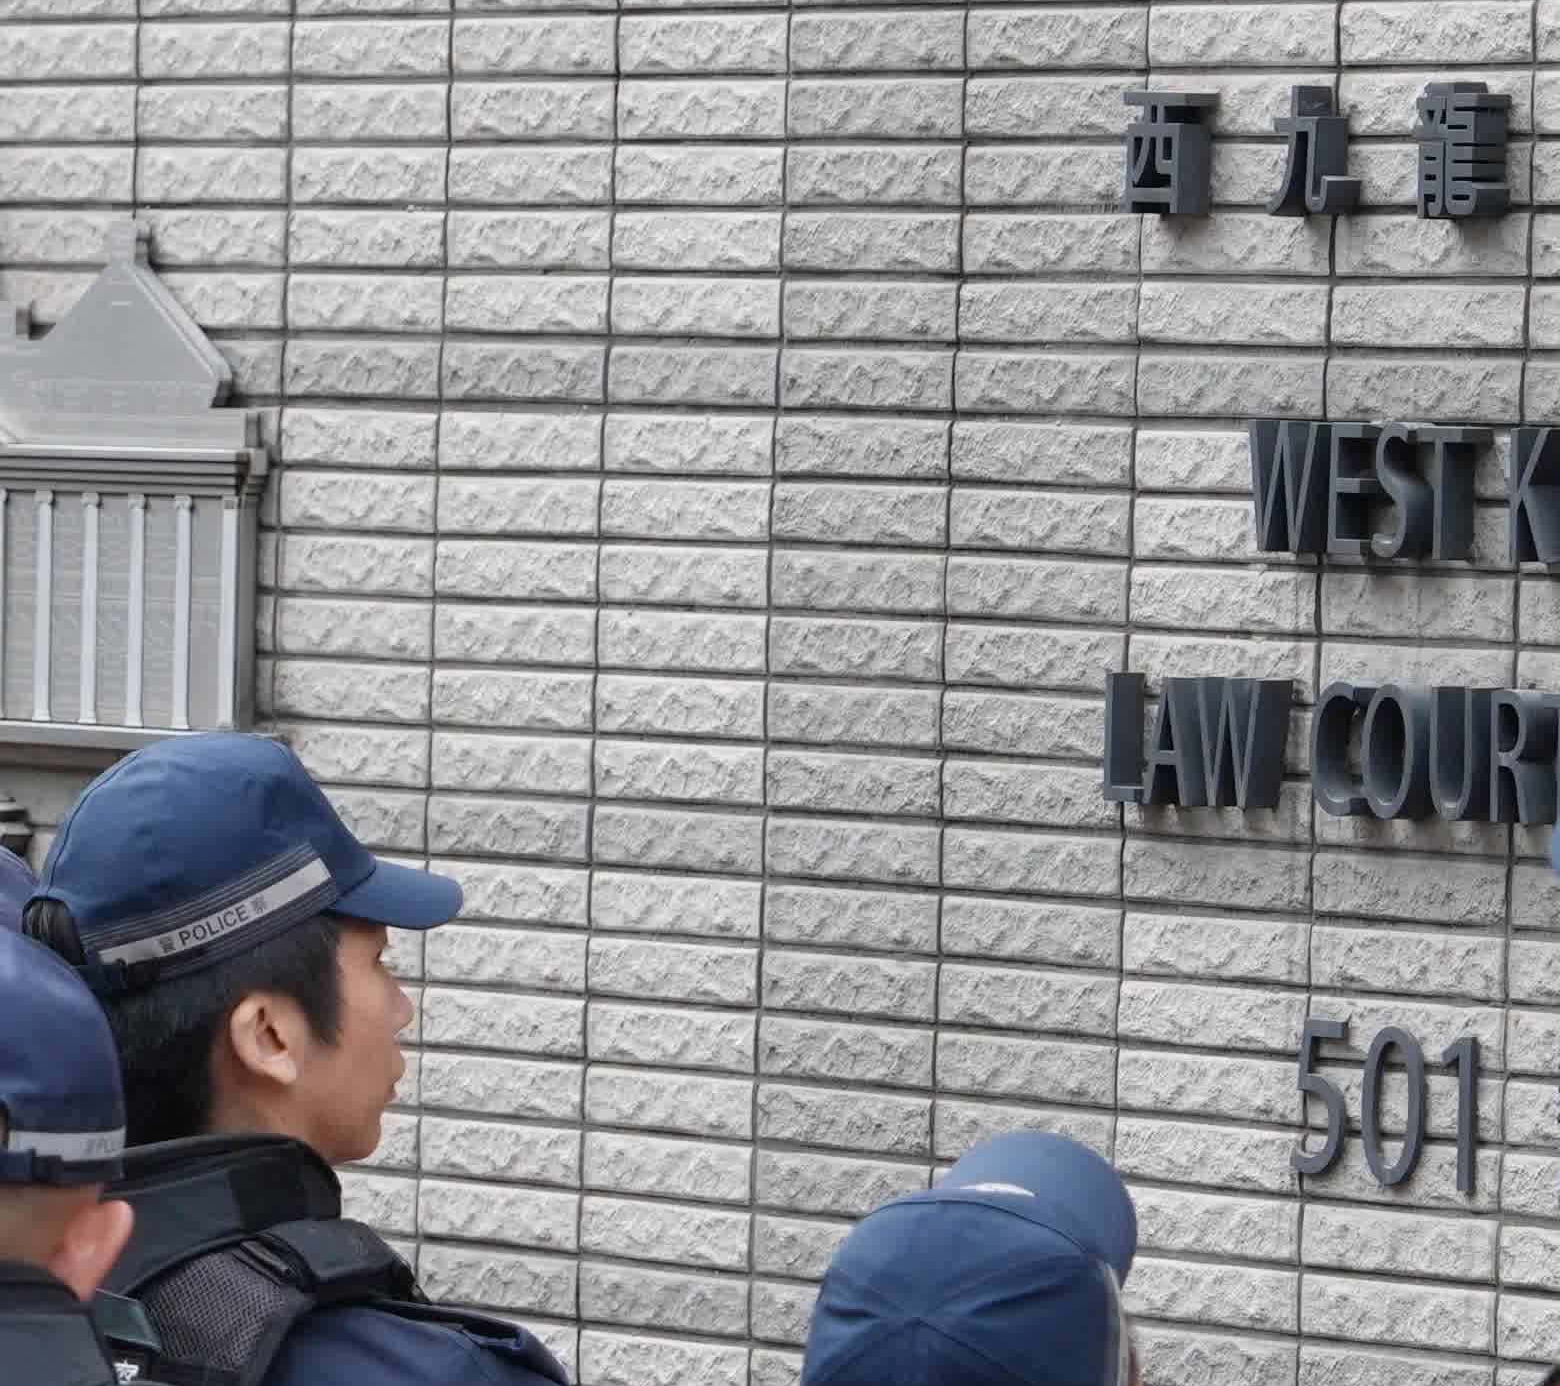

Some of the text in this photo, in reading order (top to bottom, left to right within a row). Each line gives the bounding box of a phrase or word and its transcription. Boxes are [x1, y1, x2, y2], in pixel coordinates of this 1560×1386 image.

[1248, 419, 1494, 558] WEST
[1104, 673, 1294, 808] LAW
[178, 905, 250, 946] POLICE
[1289, 1013, 1478, 1196] 501
